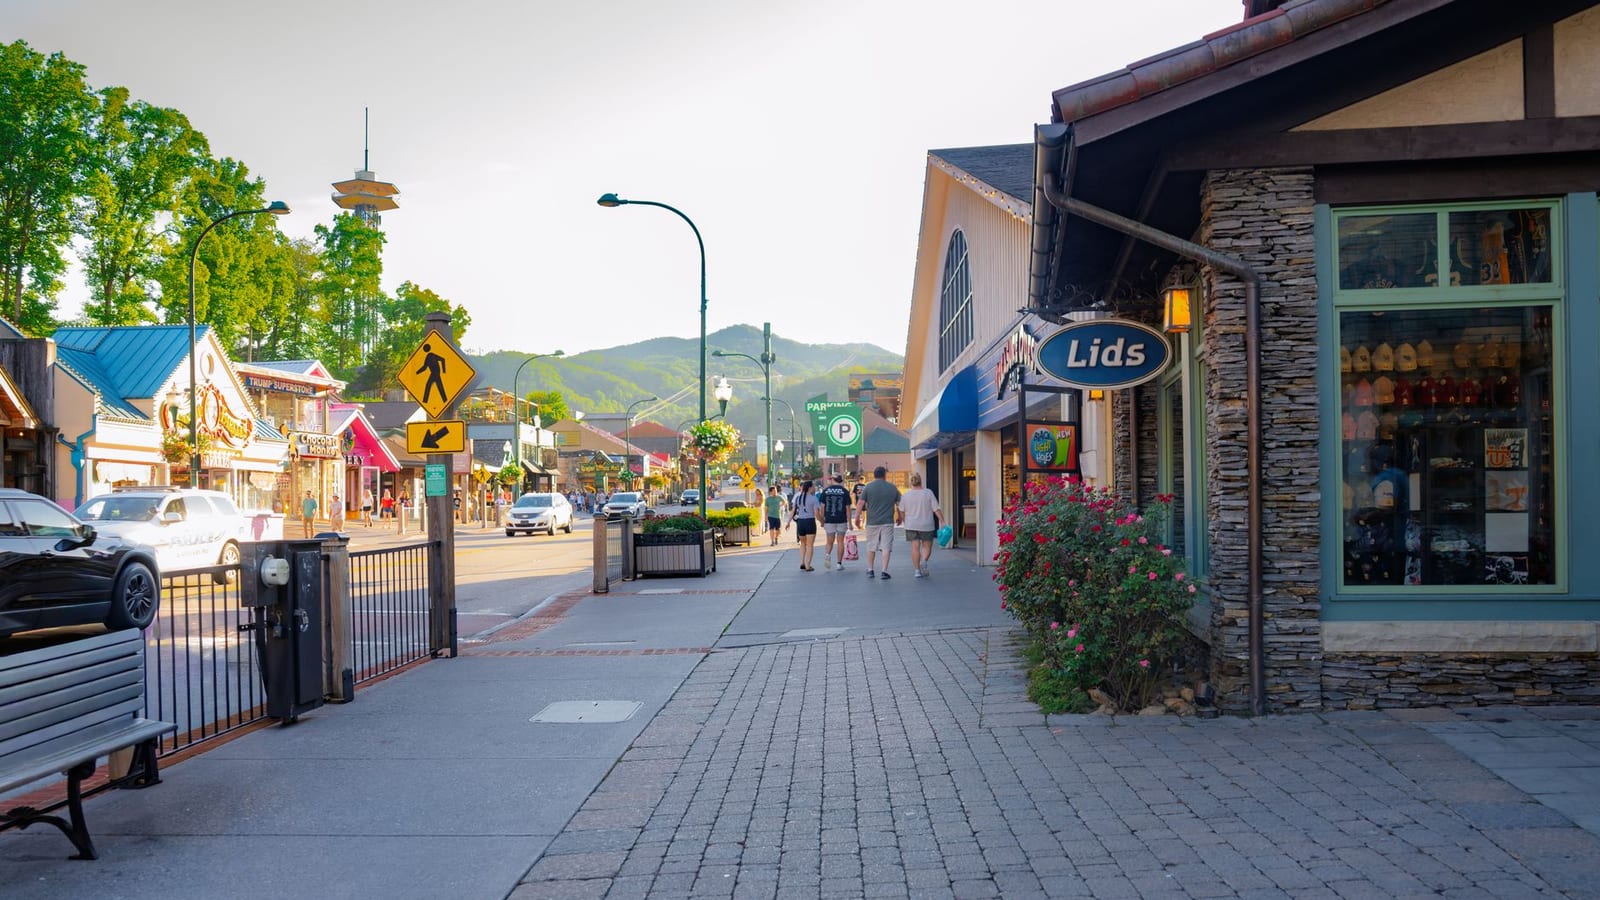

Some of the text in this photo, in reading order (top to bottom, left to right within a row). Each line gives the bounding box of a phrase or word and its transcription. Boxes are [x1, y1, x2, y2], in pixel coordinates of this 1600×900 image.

[1067, 337, 1146, 368] Lids
[249, 377, 313, 394] TRUMP SUPERSTORE
[839, 423, 851, 439] P
[1057, 430, 1072, 440] NEW
[1034, 439, 1052, 451] LIGHT
